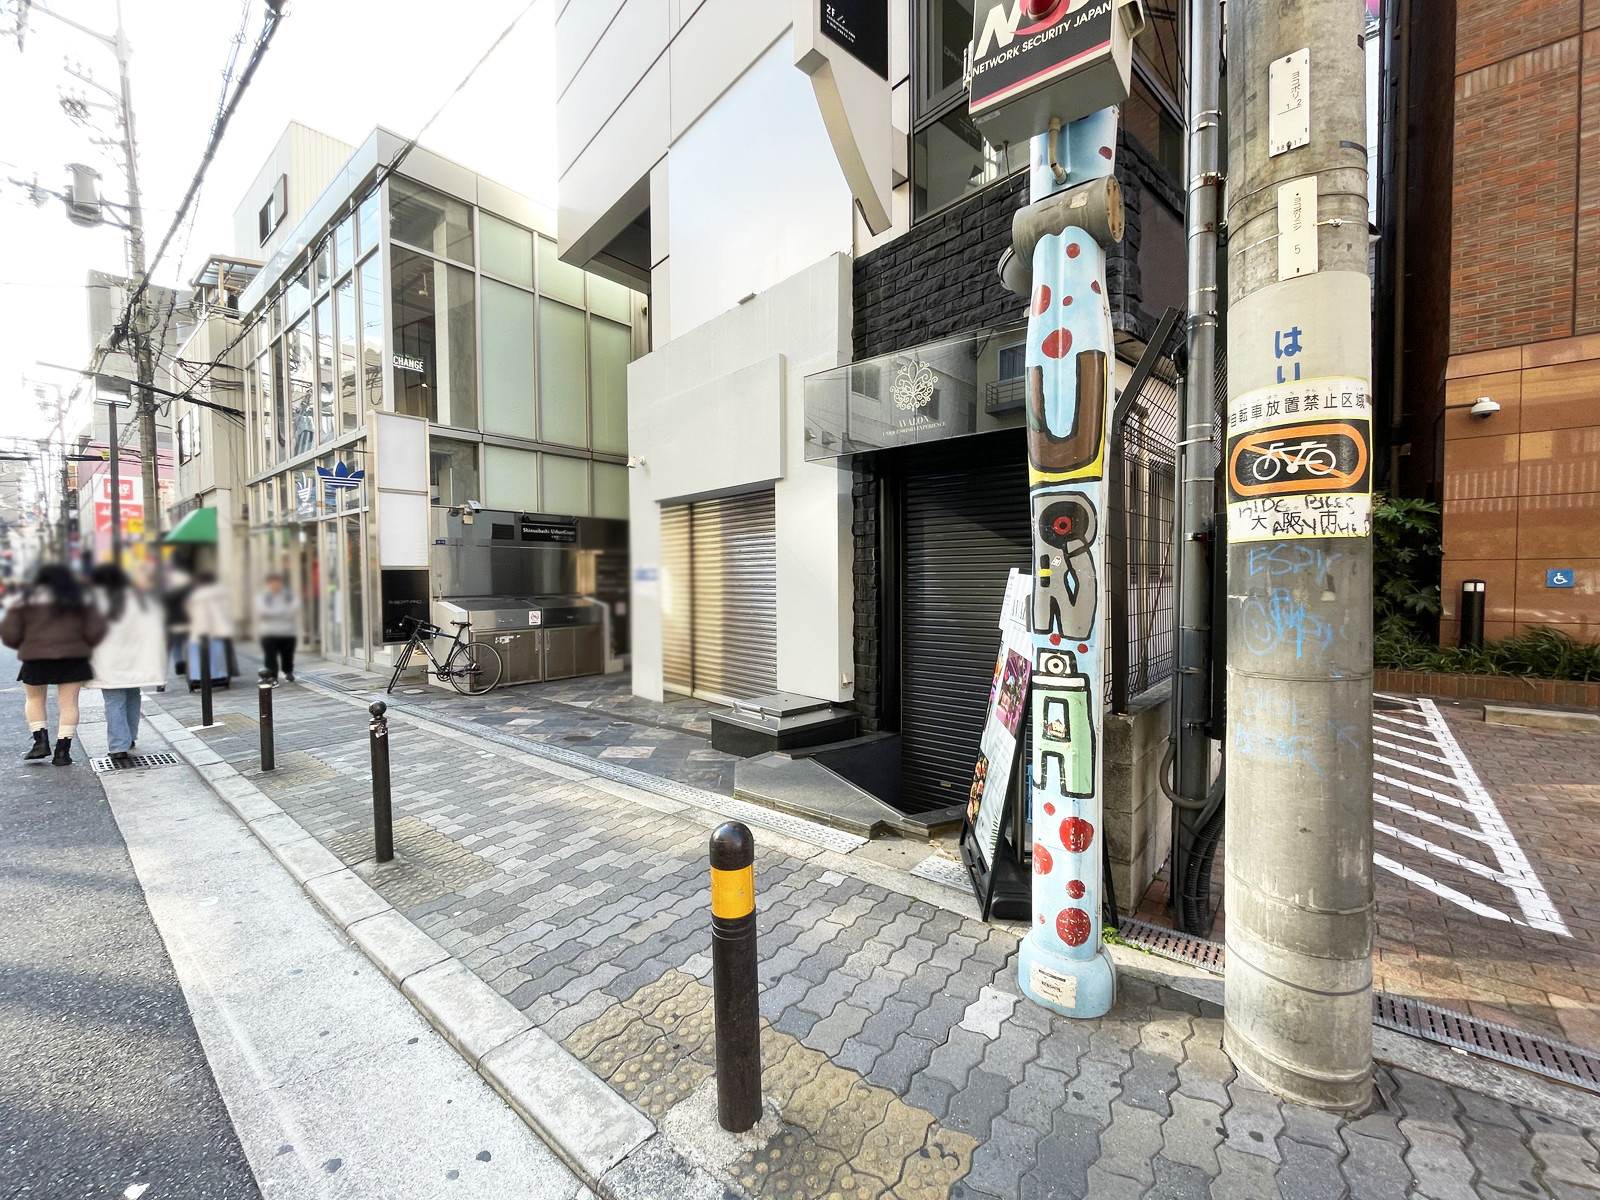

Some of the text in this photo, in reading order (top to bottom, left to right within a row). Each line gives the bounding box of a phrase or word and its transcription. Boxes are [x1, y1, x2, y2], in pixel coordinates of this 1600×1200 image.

[972, 45, 1020, 76] NETWORK
[1022, 19, 1072, 53] SECURITY
[1073, 1, 1112, 28] JAPAN
[1294, 244, 1301, 254] 5
[393, 355, 424, 371] CHANGE
[1251, 509, 1338, 531] 大阪市
